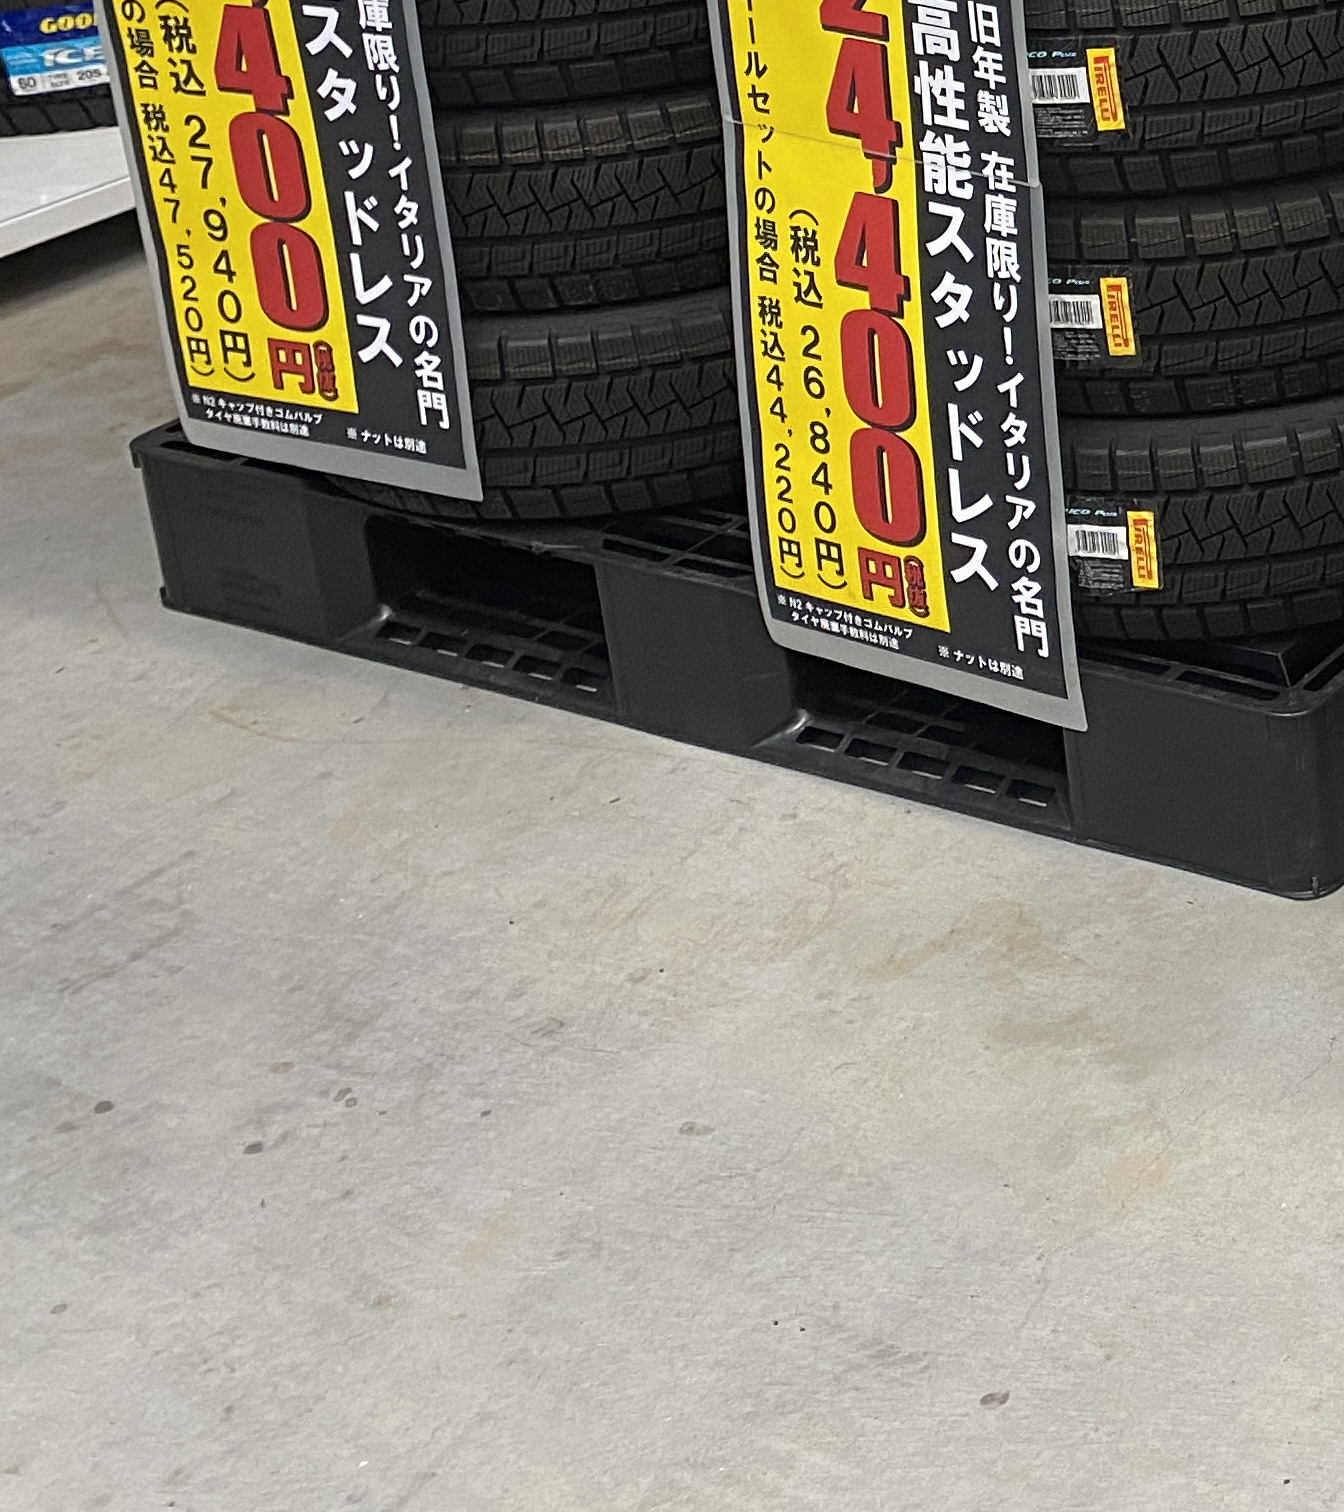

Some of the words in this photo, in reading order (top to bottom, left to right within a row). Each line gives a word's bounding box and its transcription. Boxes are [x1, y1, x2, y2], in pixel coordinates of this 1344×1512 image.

[966, 0, 1012, 138] 旧年製
[1093, 55, 1119, 123] PIRELLI
[1106, 284, 1130, 348] PIRELLI
[1132, 518, 1154, 580] PIRELLI
